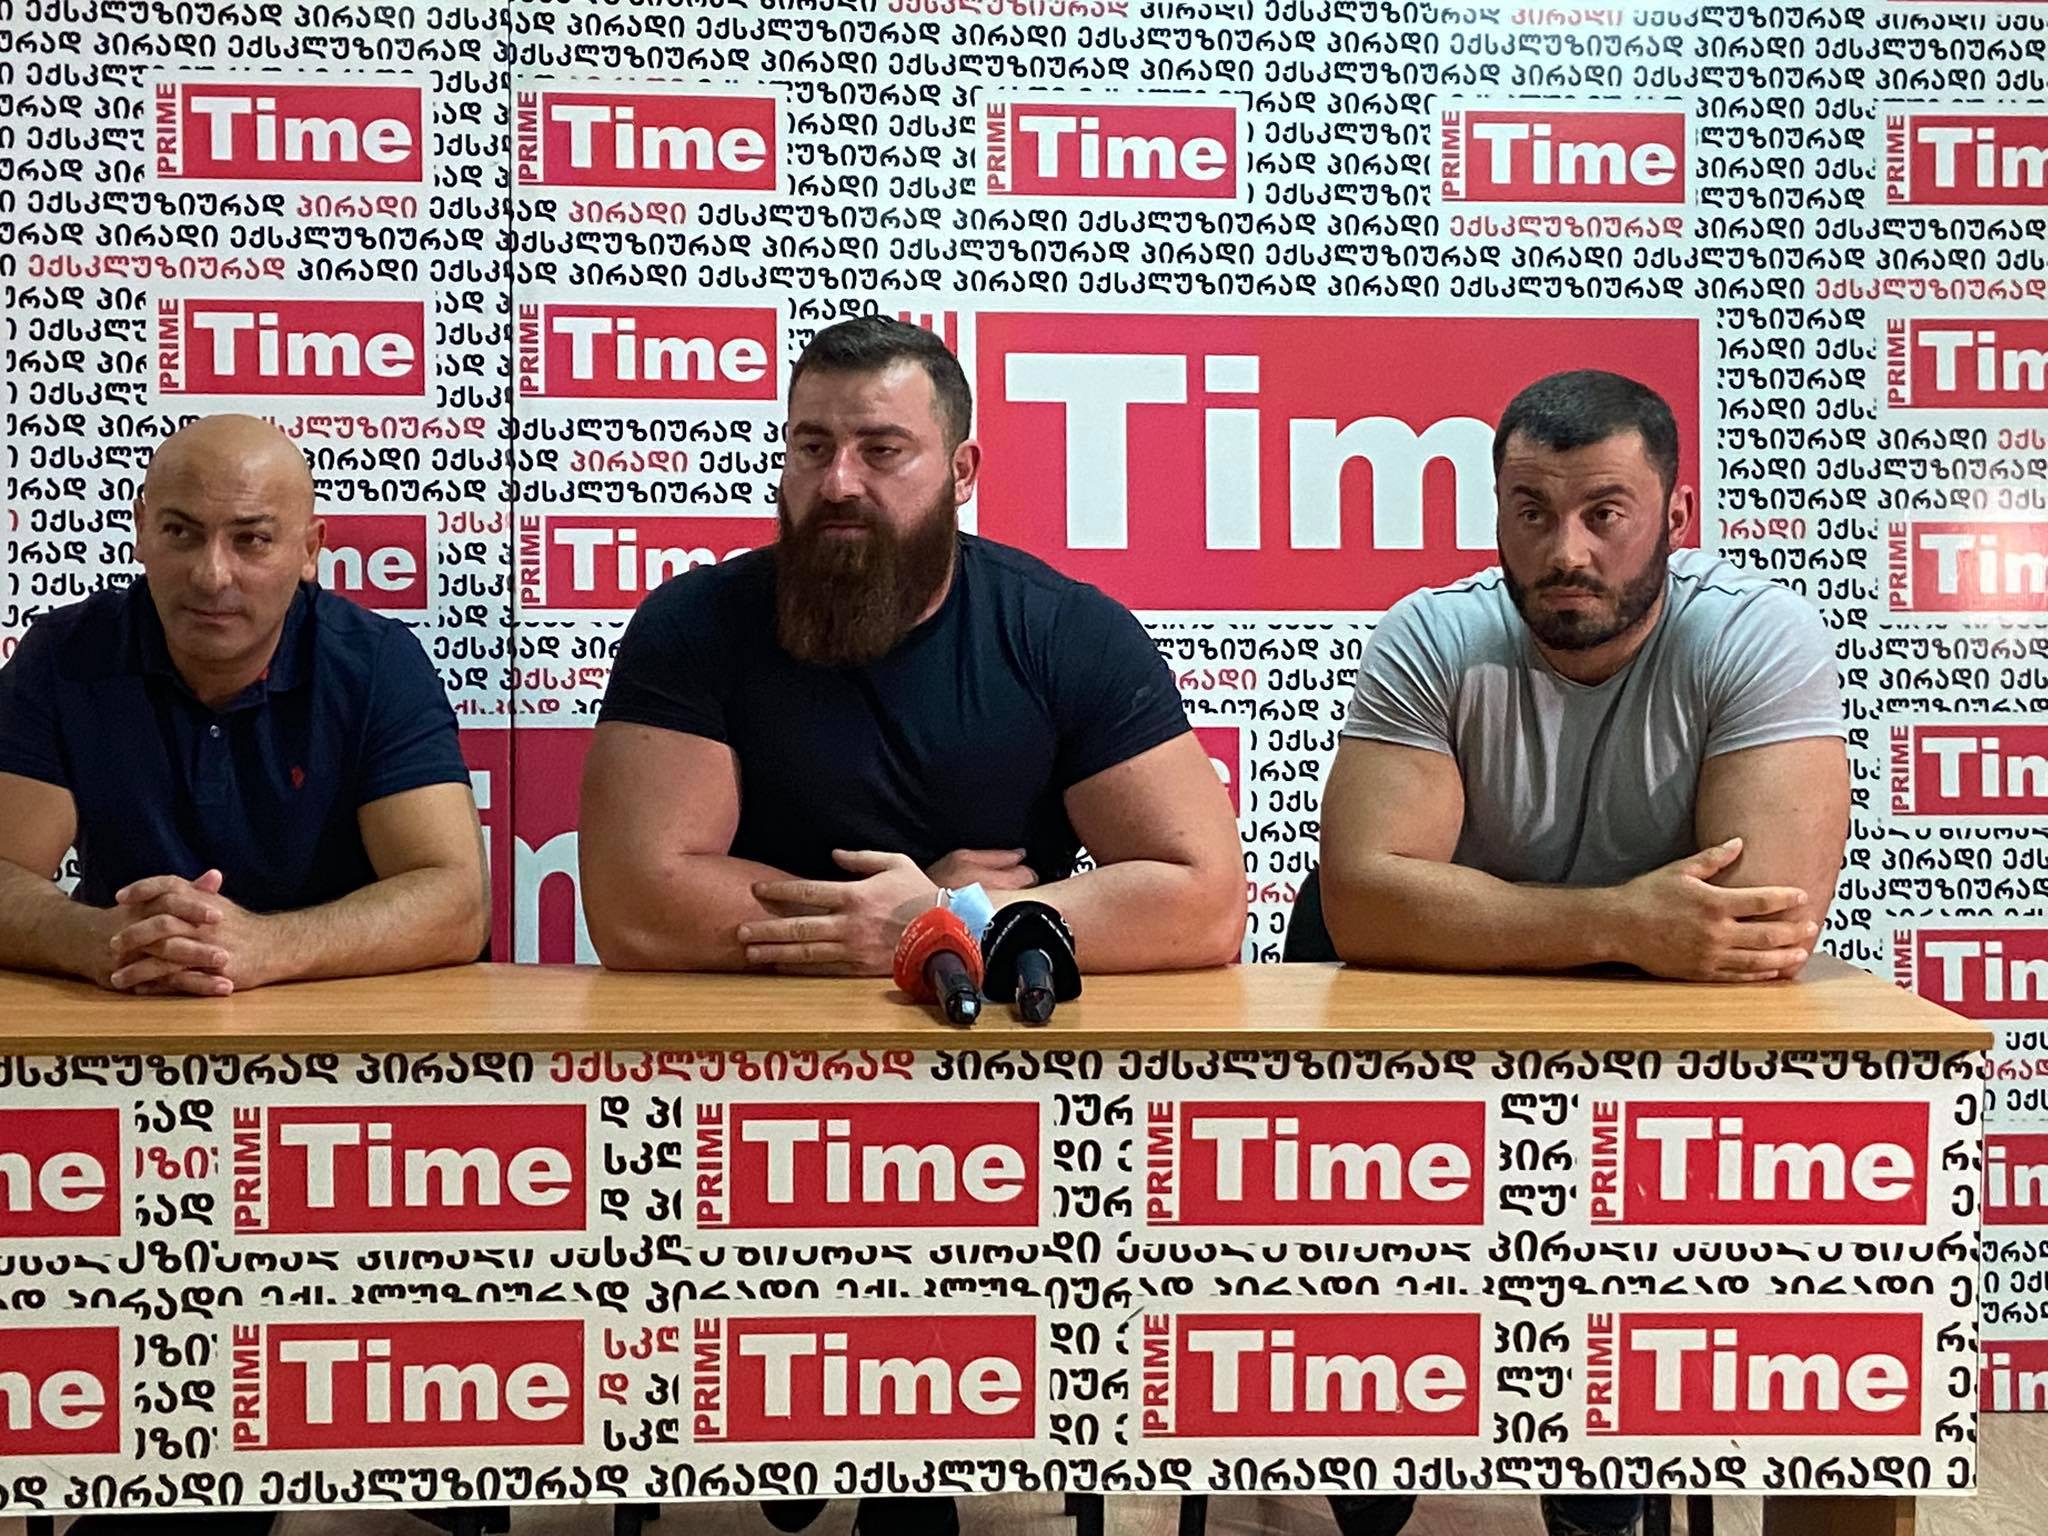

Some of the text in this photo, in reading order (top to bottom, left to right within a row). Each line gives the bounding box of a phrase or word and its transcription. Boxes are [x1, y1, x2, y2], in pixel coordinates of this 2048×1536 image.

[25, 0, 415, 29] ექსკლუზიურად პირადი
[93, 32, 216, 57] პირადი
[228, 35, 481, 61] ექსკლუზიურად
[567, 13, 2046, 61] პირადი ექსკლუზიურად პირადი ექსკლუზიურად პირადი ექსკლუზიურად პირადი ექსკლუზიურად
[1265, 0, 1500, 24] ექსკლუზიურად
[1634, 6, 1865, 29] ექსკლუზიურად
[761, 50, 877, 74] პირადი
[889, 52, 1129, 79] ექსკლუზიურად
[1140, 58, 1254, 81] პირადი
[1265, 61, 1500, 85] ექსკლუზიურად
[1512, 64, 1622, 86] პირადი
[1633, 66, 1865, 89] ექსკლუზიურად
[1876, 68, 1985, 90] პირადი
[156, 83, 177, 172] PRIME
[191, 97, 412, 163] Time
[517, 91, 538, 180] PRIME
[552, 105, 766, 172] Time
[1696, 96, 1804, 119] პირადი
[787, 143, 941, 168] უზიურად
[986, 103, 1006, 190] PRIME
[1019, 116, 1227, 180] Time
[1441, 110, 1460, 196] PRIME
[1473, 123, 1676, 185] Time
[1696, 157, 1804, 179] პირადი
[1886, 115, 1904, 200] PRIME
[27, 190, 417, 218] ექსკლუზიურად პირადი
[569, 201, 2046, 240] პირადი ექსკლუზიურად პირადი ექსკლუზიურად პირადი ექსკლუზიურად პირადი ექსკლუზიურად
[28, 254, 418, 281] ექსკლუზიურად პირადი
[96, 223, 483, 251] პირადი ექსკლუზიურად
[762, 235, 878, 259] პირადი
[890, 238, 1129, 263] ექსკლუზიურად
[1141, 242, 1254, 265] პირადი
[1266, 243, 1500, 267] ექსკლუზიურად
[1512, 246, 1622, 268] პირადი
[1633, 247, 1865, 270] ექსკლუზიურად
[1876, 248, 1986, 270] პირადი
[569, 263, 2046, 300] პირადი ექსკლუზიურად პირადი ექსკლუზიურად პირადი ექსკლუზიურად პირადი ექსკლუზიურად
[158, 298, 179, 388] PRIME
[194, 312, 414, 377] Time
[519, 304, 539, 391] PRIME
[553, 317, 767, 382] Time
[1717, 307, 1865, 329] უზიურად
[1717, 368, 1865, 389] უზიურად
[1887, 318, 1905, 402] PRIME
[570, 450, 688, 472] პირადი
[1005, 353, 1497, 550] Tim
[1717, 428, 1987, 450] უზიურად პირადი
[1817, 458, 2047, 480] ექსკლუზიურად
[1718, 488, 1987, 510] უზიურად პირადი
[520, 515, 540, 603] PRIME
[554, 528, 758, 591] Tim
[1889, 522, 1907, 606] PRIME
[1879, 668, 1989, 690] პირადი
[1891, 725, 1909, 811] PRIME
[1882, 848, 1992, 870] პირადი
[1894, 929, 1912, 990] RIME
[356, 1053, 533, 1085] პირადი
[551, 1051, 914, 1083] ექსკლუზიურად
[931, 1051, 1102, 1081] პირადი
[1119, 1050, 1476, 1081] ექსკლუზიურად
[1492, 1050, 1661, 1080] პირადი
[233, 1107, 261, 1227] PRIME
[281, 1123, 572, 1207] Time
[697, 1103, 723, 1222] PRIME
[742, 1120, 1025, 1203] Time
[1147, 1101, 1173, 1219] PRIME
[1192, 1118, 1471, 1201] Time
[1591, 1101, 1618, 1218] PRIME
[1637, 1118, 1914, 1201] Time
[233, 1324, 260, 1443] PRIME
[280, 1339, 570, 1423] Time
[693, 1317, 720, 1436] PRIME
[740, 1333, 1021, 1416] Time
[1142, 1313, 1169, 1430] PRIME
[1188, 1330, 1466, 1412] Time
[1586, 1311, 1613, 1429] PRIME
[1632, 1329, 1908, 1411] Time
[64, 1456, 1930, 1508] პირადი ექსკლუზიურად პირადი ექსკლუზიურად პირადი ექსკლუზიურად პირადი
